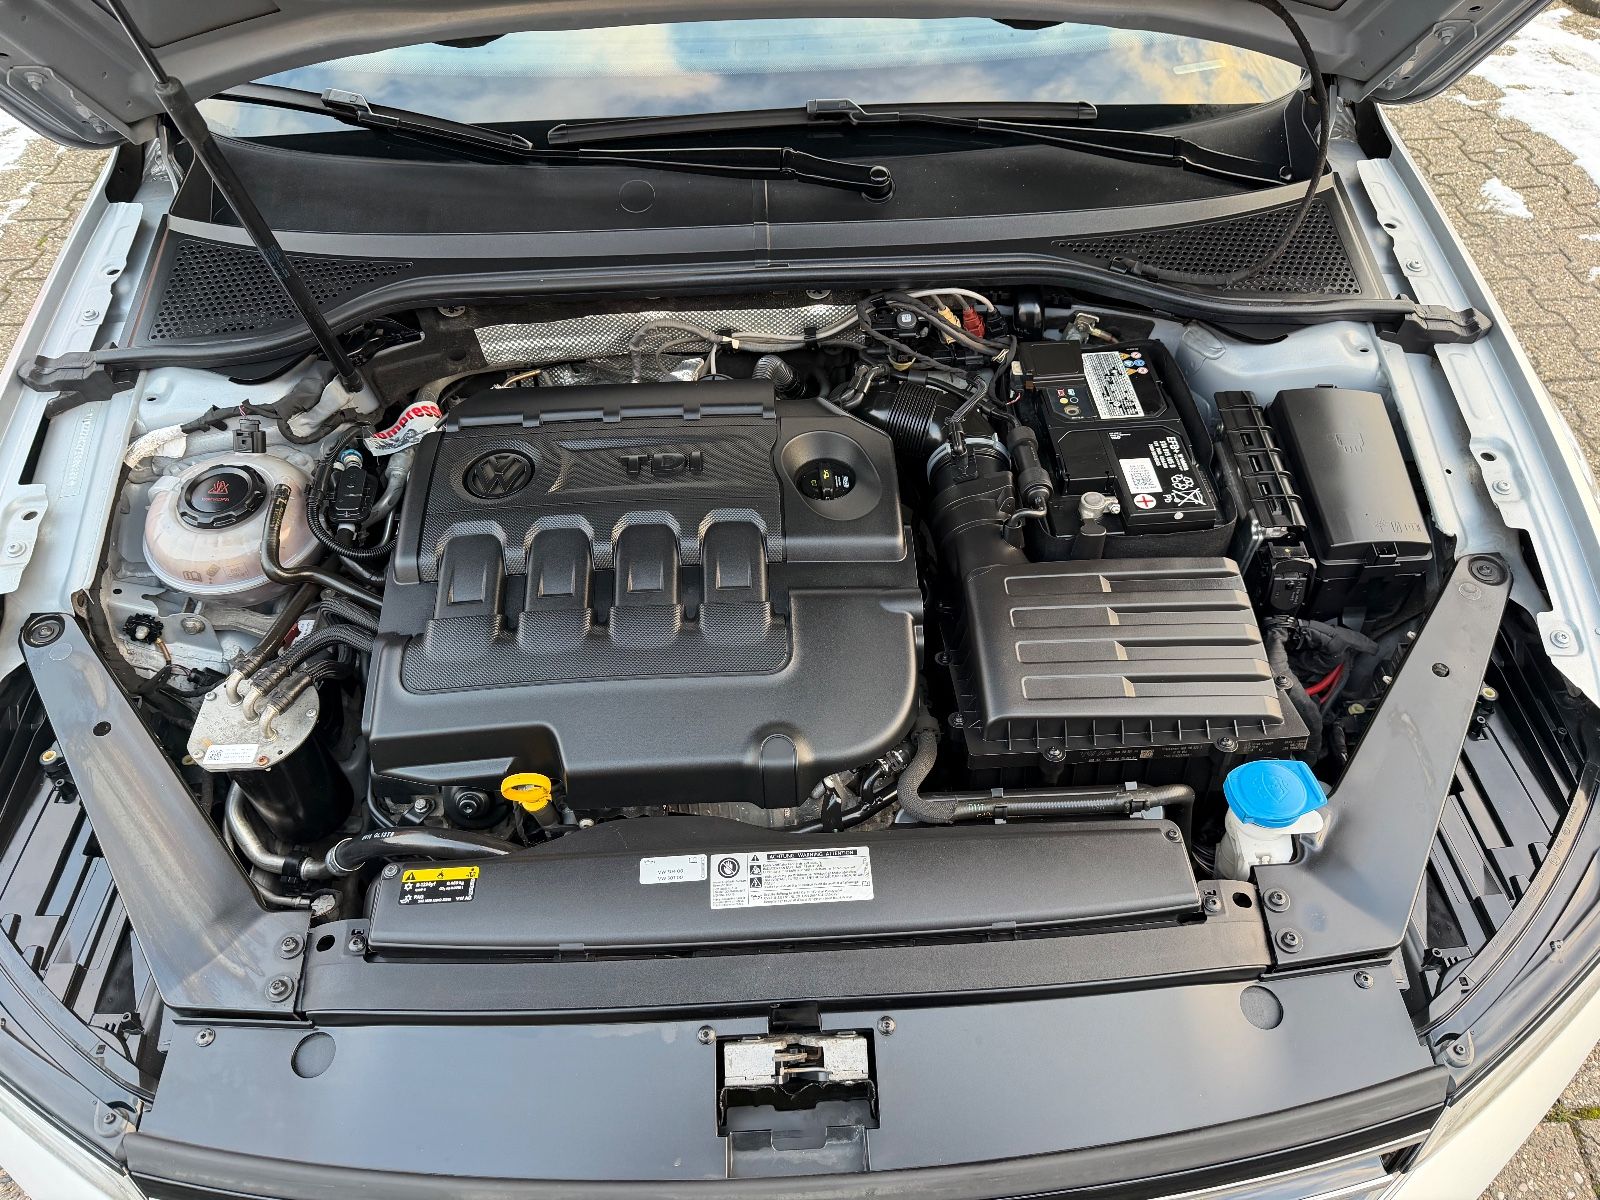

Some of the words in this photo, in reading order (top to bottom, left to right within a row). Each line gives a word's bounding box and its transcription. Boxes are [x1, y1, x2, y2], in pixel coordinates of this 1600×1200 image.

[1166, 436, 1180, 453] EFB+
[620, 450, 703, 475] TDI
[1163, 495, 1172, 503] Pb
